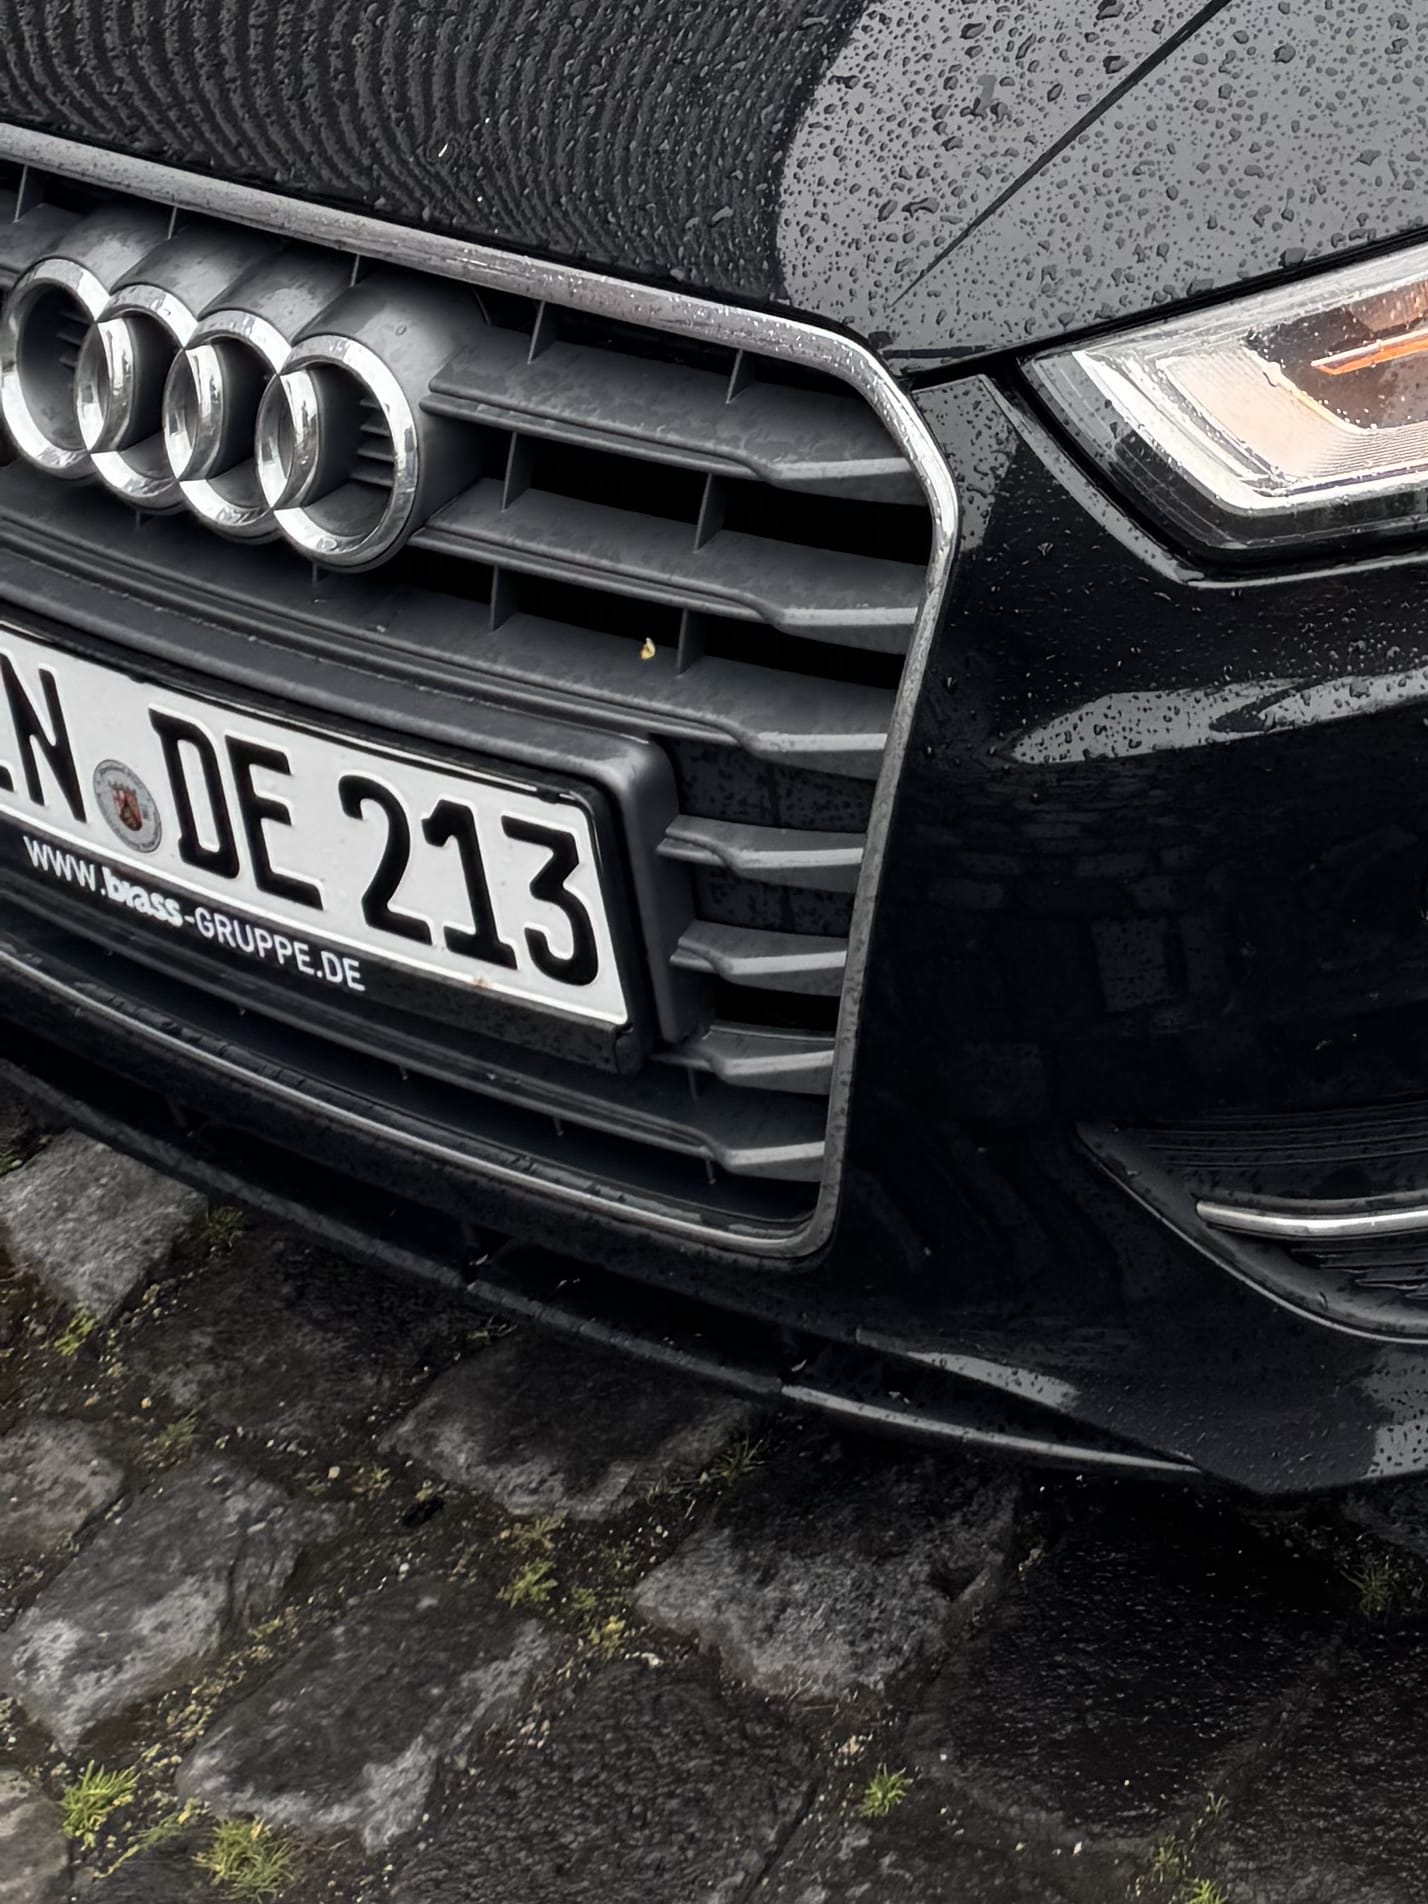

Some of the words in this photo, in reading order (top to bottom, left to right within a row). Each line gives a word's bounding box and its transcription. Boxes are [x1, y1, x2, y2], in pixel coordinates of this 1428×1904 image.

[0, 647, 88, 824] N
[148, 708, 325, 911] DE
[338, 774, 599, 986] 213
